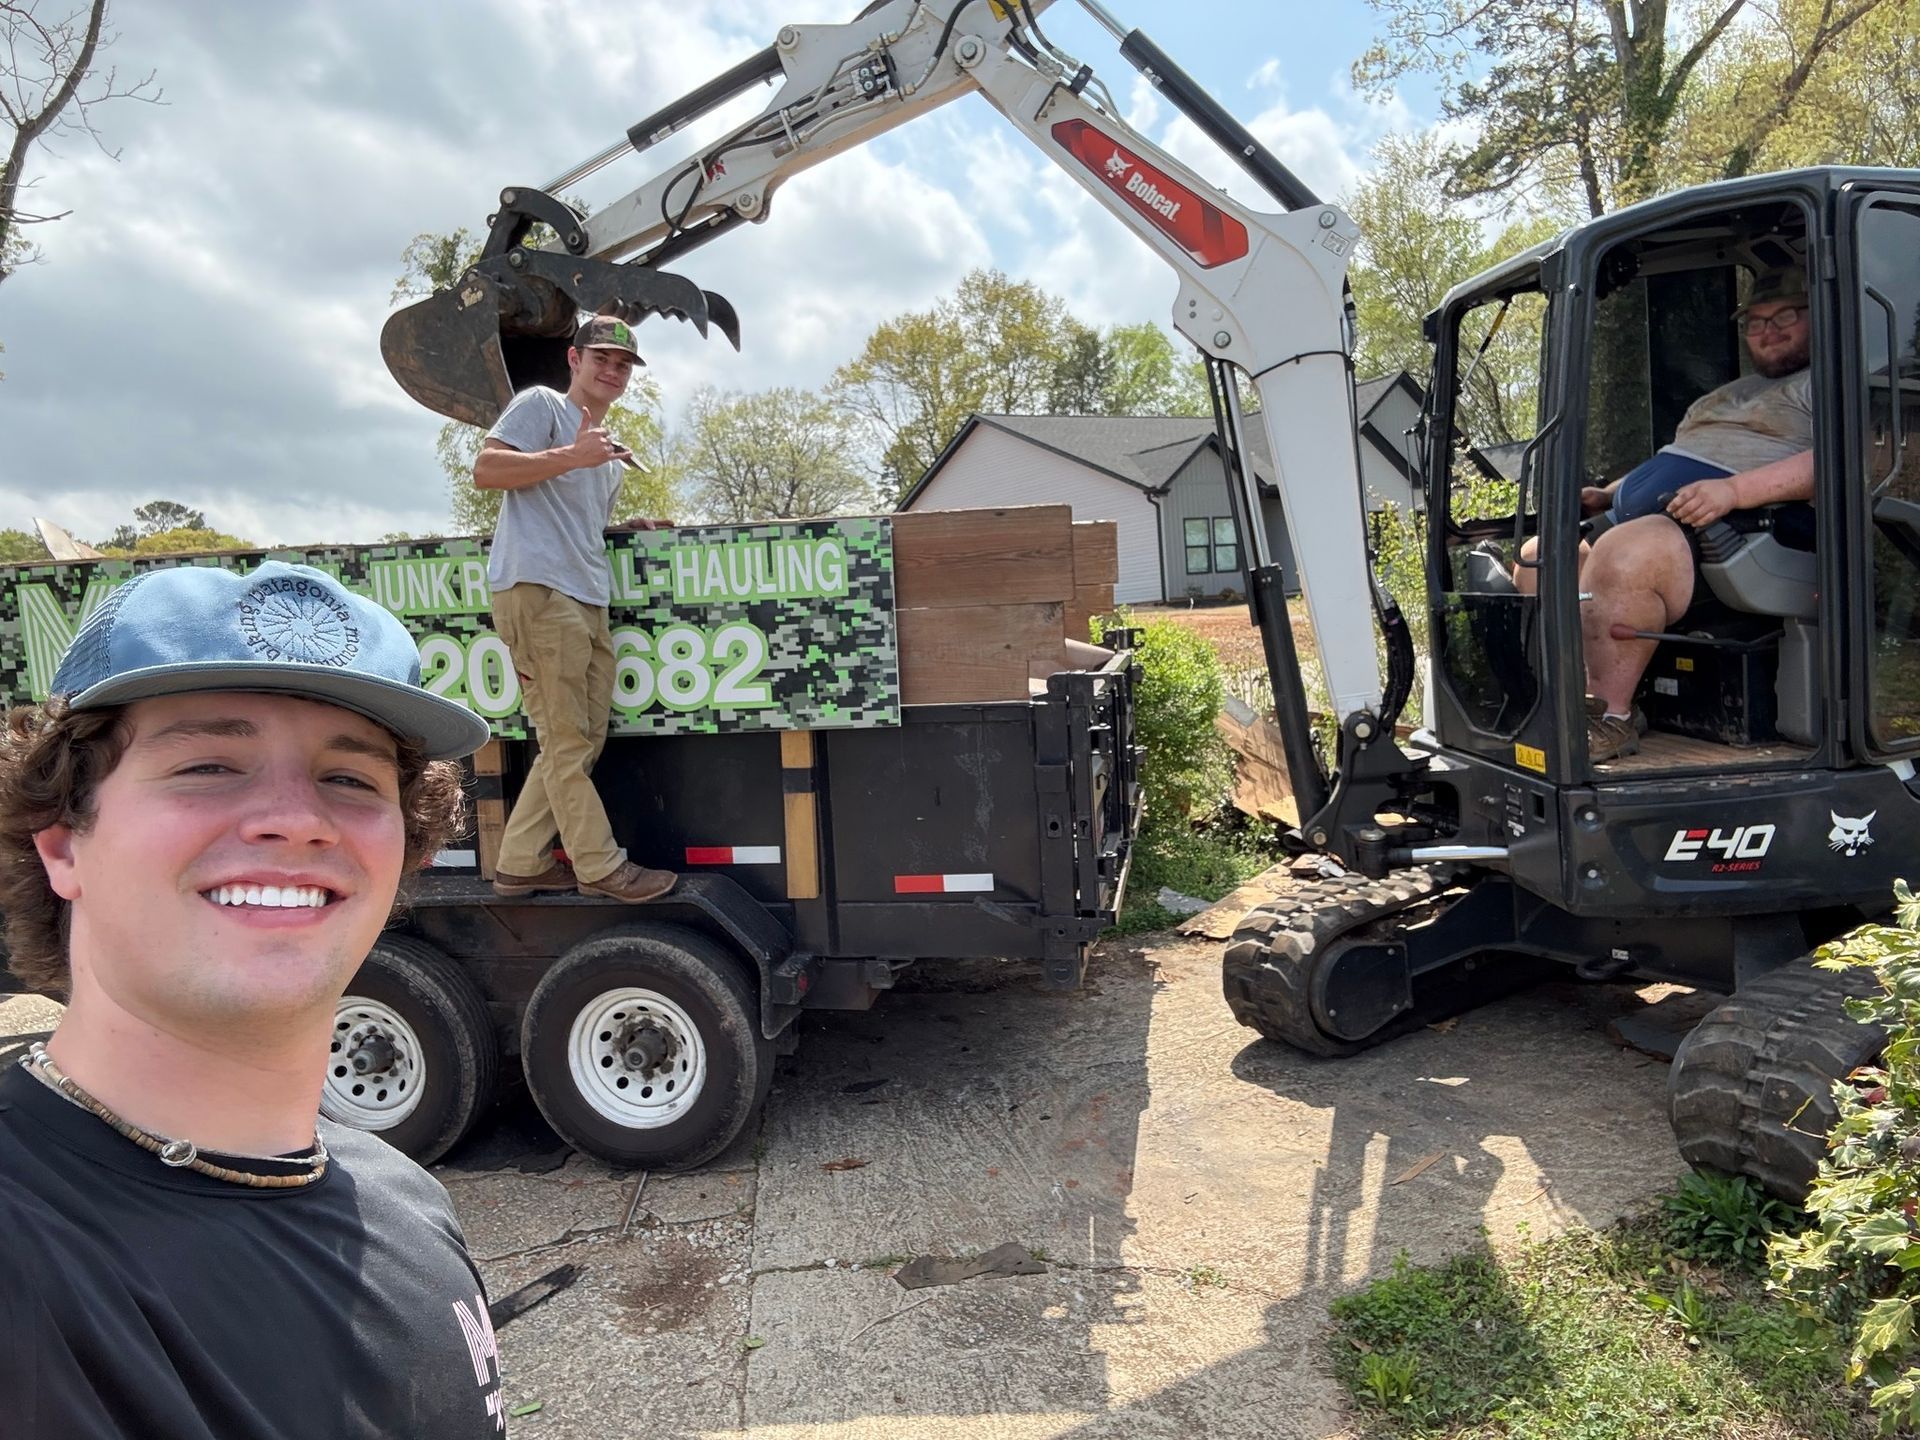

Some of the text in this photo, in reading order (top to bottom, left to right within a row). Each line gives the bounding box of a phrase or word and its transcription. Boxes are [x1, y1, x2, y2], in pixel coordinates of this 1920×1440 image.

[1125, 172, 1181, 222] Bobcat
[675, 542, 842, 598] HAULING
[248, 577, 350, 622] patagonia
[1664, 824, 1776, 861] E40
[1711, 861, 1761, 873] R2-SERIES
